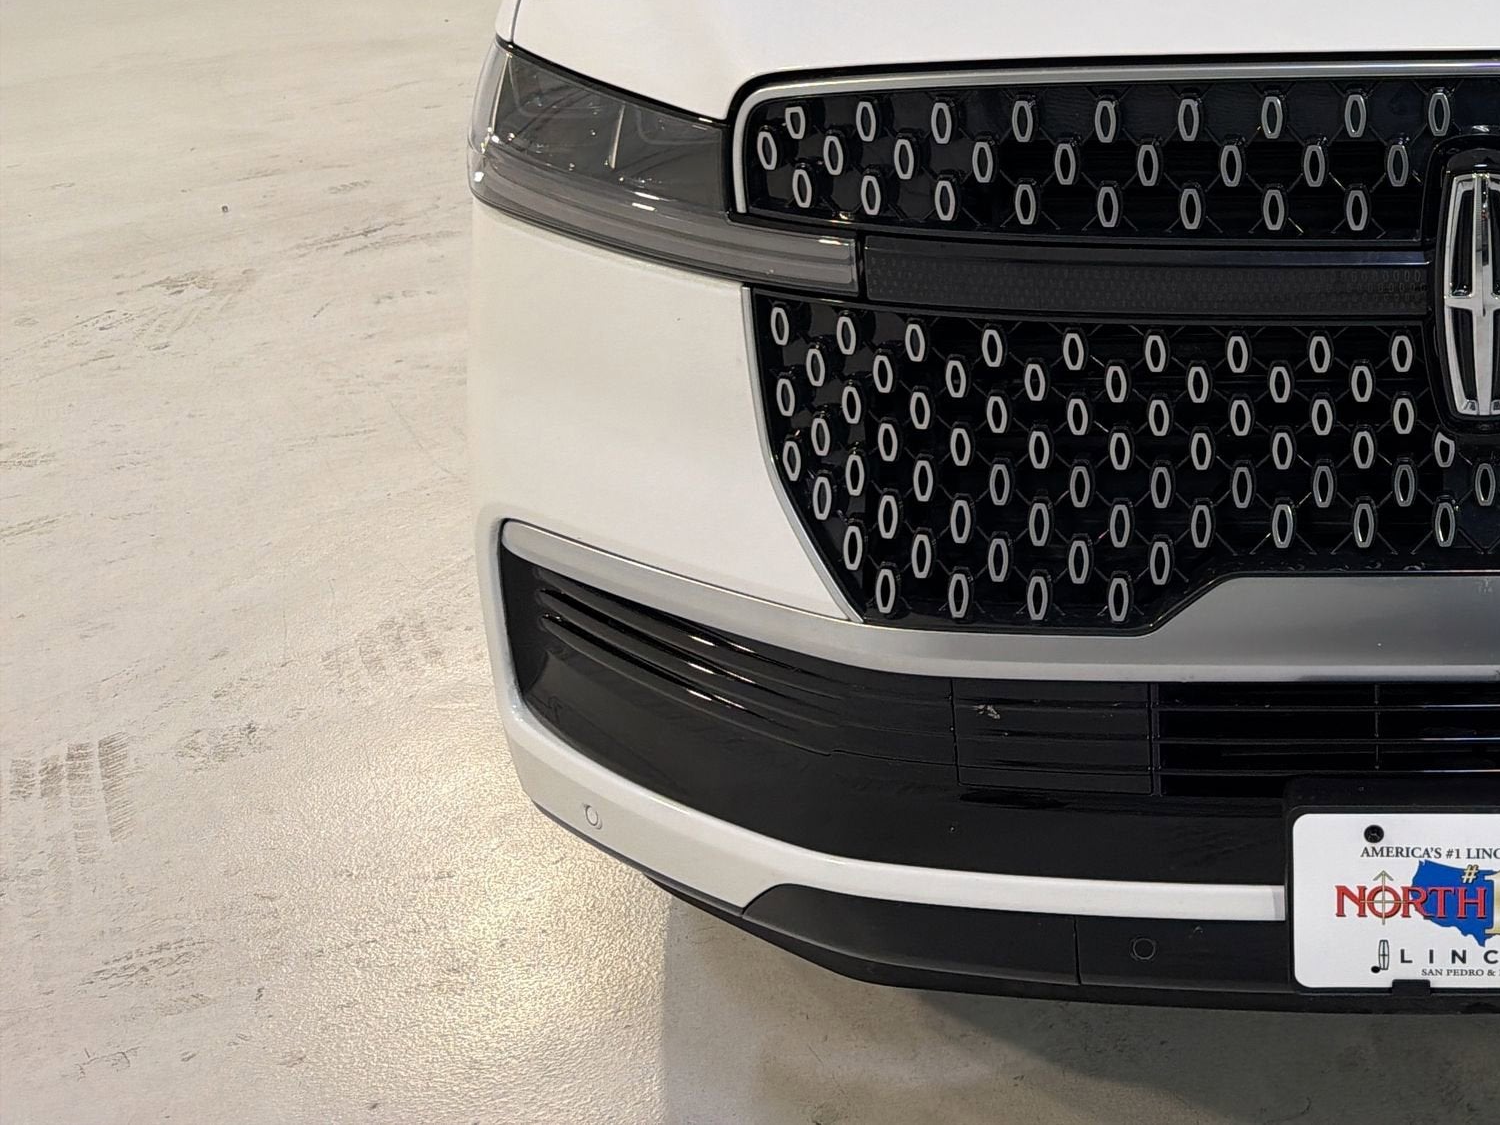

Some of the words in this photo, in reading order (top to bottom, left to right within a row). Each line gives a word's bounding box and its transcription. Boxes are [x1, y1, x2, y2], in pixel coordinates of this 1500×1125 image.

[1360, 846, 1442, 859] AMERICA'S
[1446, 848, 1461, 859] #1
[1335, 885, 1487, 919] NORTH
[1421, 968, 1443, 977] SAN
[1446, 968, 1484, 977] PEDRO
[1487, 968, 1496, 977] &
